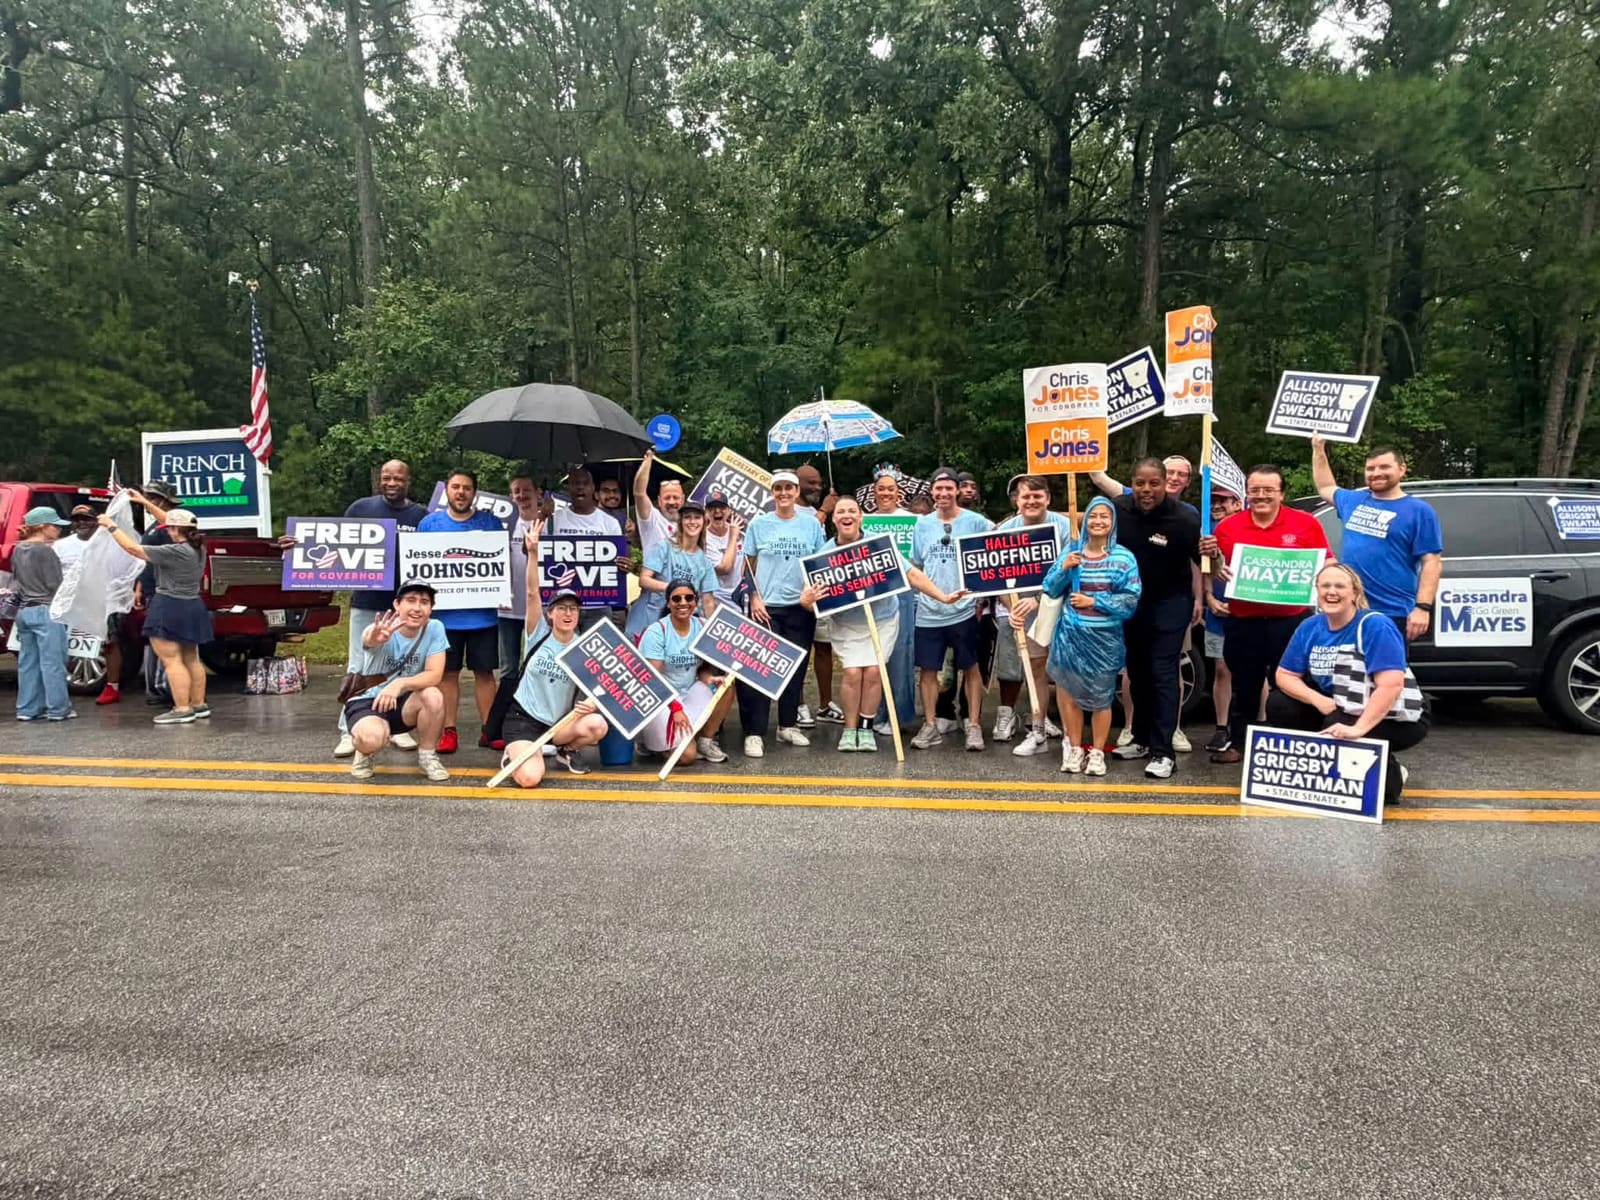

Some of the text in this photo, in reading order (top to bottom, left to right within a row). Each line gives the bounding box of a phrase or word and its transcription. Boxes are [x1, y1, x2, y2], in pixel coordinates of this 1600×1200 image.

[1050, 371, 1089, 388] Chris
[1284, 379, 1342, 395] ALLISON
[1032, 385, 1100, 406] Jones
[1281, 391, 1337, 407] GRIGSBY
[1053, 401, 1100, 411] CONGRESS
[1277, 403, 1353, 422] SWEATMAN
[1051, 426, 1090, 441] Chris
[1289, 418, 1334, 430] STATE SENATE
[1035, 439, 1100, 458] Jones
[160, 453, 247, 474] FRENCH
[726, 454, 759, 477] SECRETARY
[161, 474, 221, 496] HILL
[715, 466, 773, 508] KELLY
[1557, 505, 1596, 513] ALLISON
[1558, 512, 1596, 520] GRIGSBY
[295, 522, 386, 545] FRED
[985, 533, 1030, 551] HALLIE
[405, 549, 442, 559] Jesse
[538, 540, 618, 562] FRED
[828, 544, 871, 568] HALLIE
[966, 544, 1053, 570] SHOFFNER
[406, 561, 506, 580] JOHNSON
[813, 552, 894, 586] SHOFFNER
[980, 562, 1042, 581] US SENATE
[1243, 556, 1313, 569] CASSANDRA
[291, 572, 384, 581] FOR GOVERNOR
[829, 571, 887, 597] US SENATE
[1240, 565, 1313, 584] MAYES
[576, 588, 619, 598] VERNOR
[1440, 590, 1528, 604] Cassandra
[1440, 605, 1526, 632] MAYES
[1491, 606, 1519, 616] Green
[738, 622, 780, 652] HALLIE
[712, 622, 790, 674] SHOFFNER
[612, 643, 653, 686] HALLIE
[715, 639, 772, 678] US SENATE
[583, 657, 635, 712] US SENATE
[585, 637, 656, 712] SHOFFNER
[1255, 737, 1336, 760] ALLISON
[1253, 752, 1334, 775] GRIGSBY
[1252, 767, 1364, 797] SWEATMAN
[1272, 788, 1339, 805] STATE SENATE
